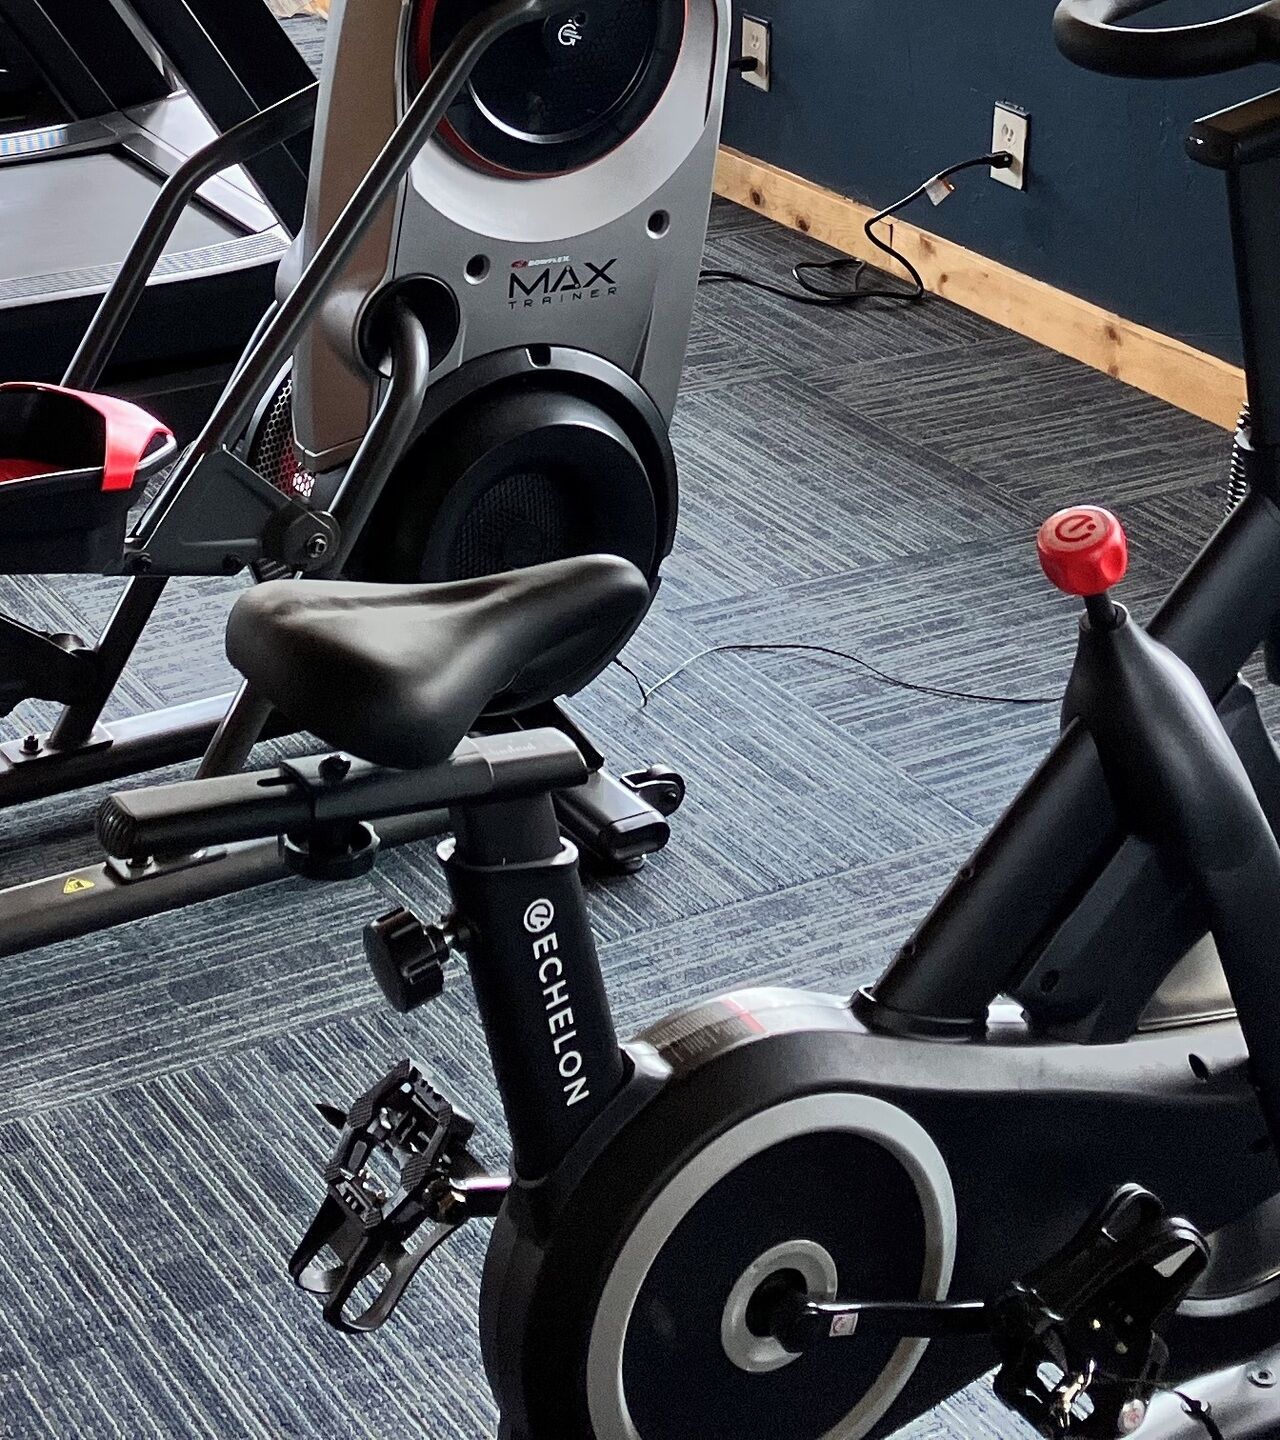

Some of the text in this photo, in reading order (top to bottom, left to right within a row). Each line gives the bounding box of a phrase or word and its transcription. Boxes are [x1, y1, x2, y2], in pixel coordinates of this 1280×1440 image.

[508, 258, 618, 299] MAX
[508, 286, 618, 310] TRAINER
[532, 931, 590, 1107] ECHELON
